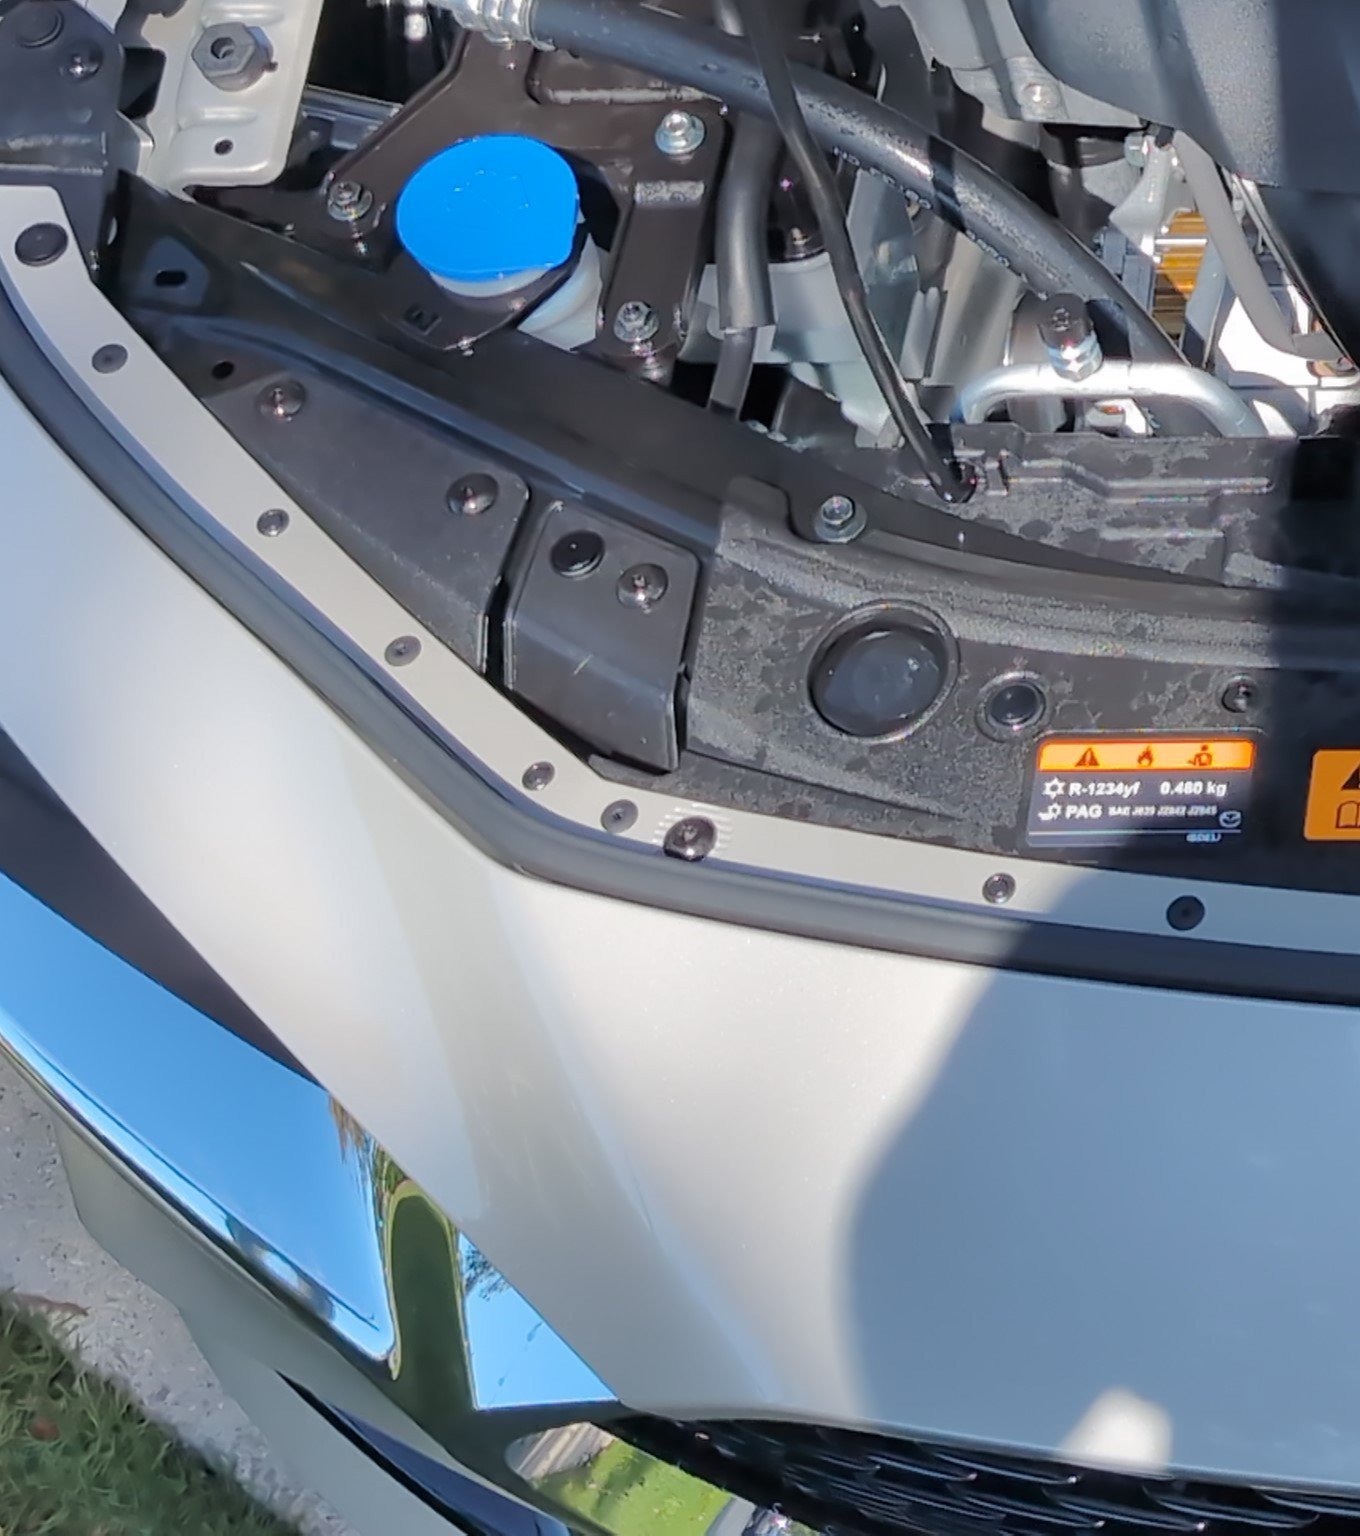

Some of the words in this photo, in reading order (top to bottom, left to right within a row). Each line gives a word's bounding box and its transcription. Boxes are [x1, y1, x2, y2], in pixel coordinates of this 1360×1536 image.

[1068, 780, 1140, 798] R-1234yf
[1206, 781, 1227, 797] kg
[1065, 804, 1103, 819] PAG
